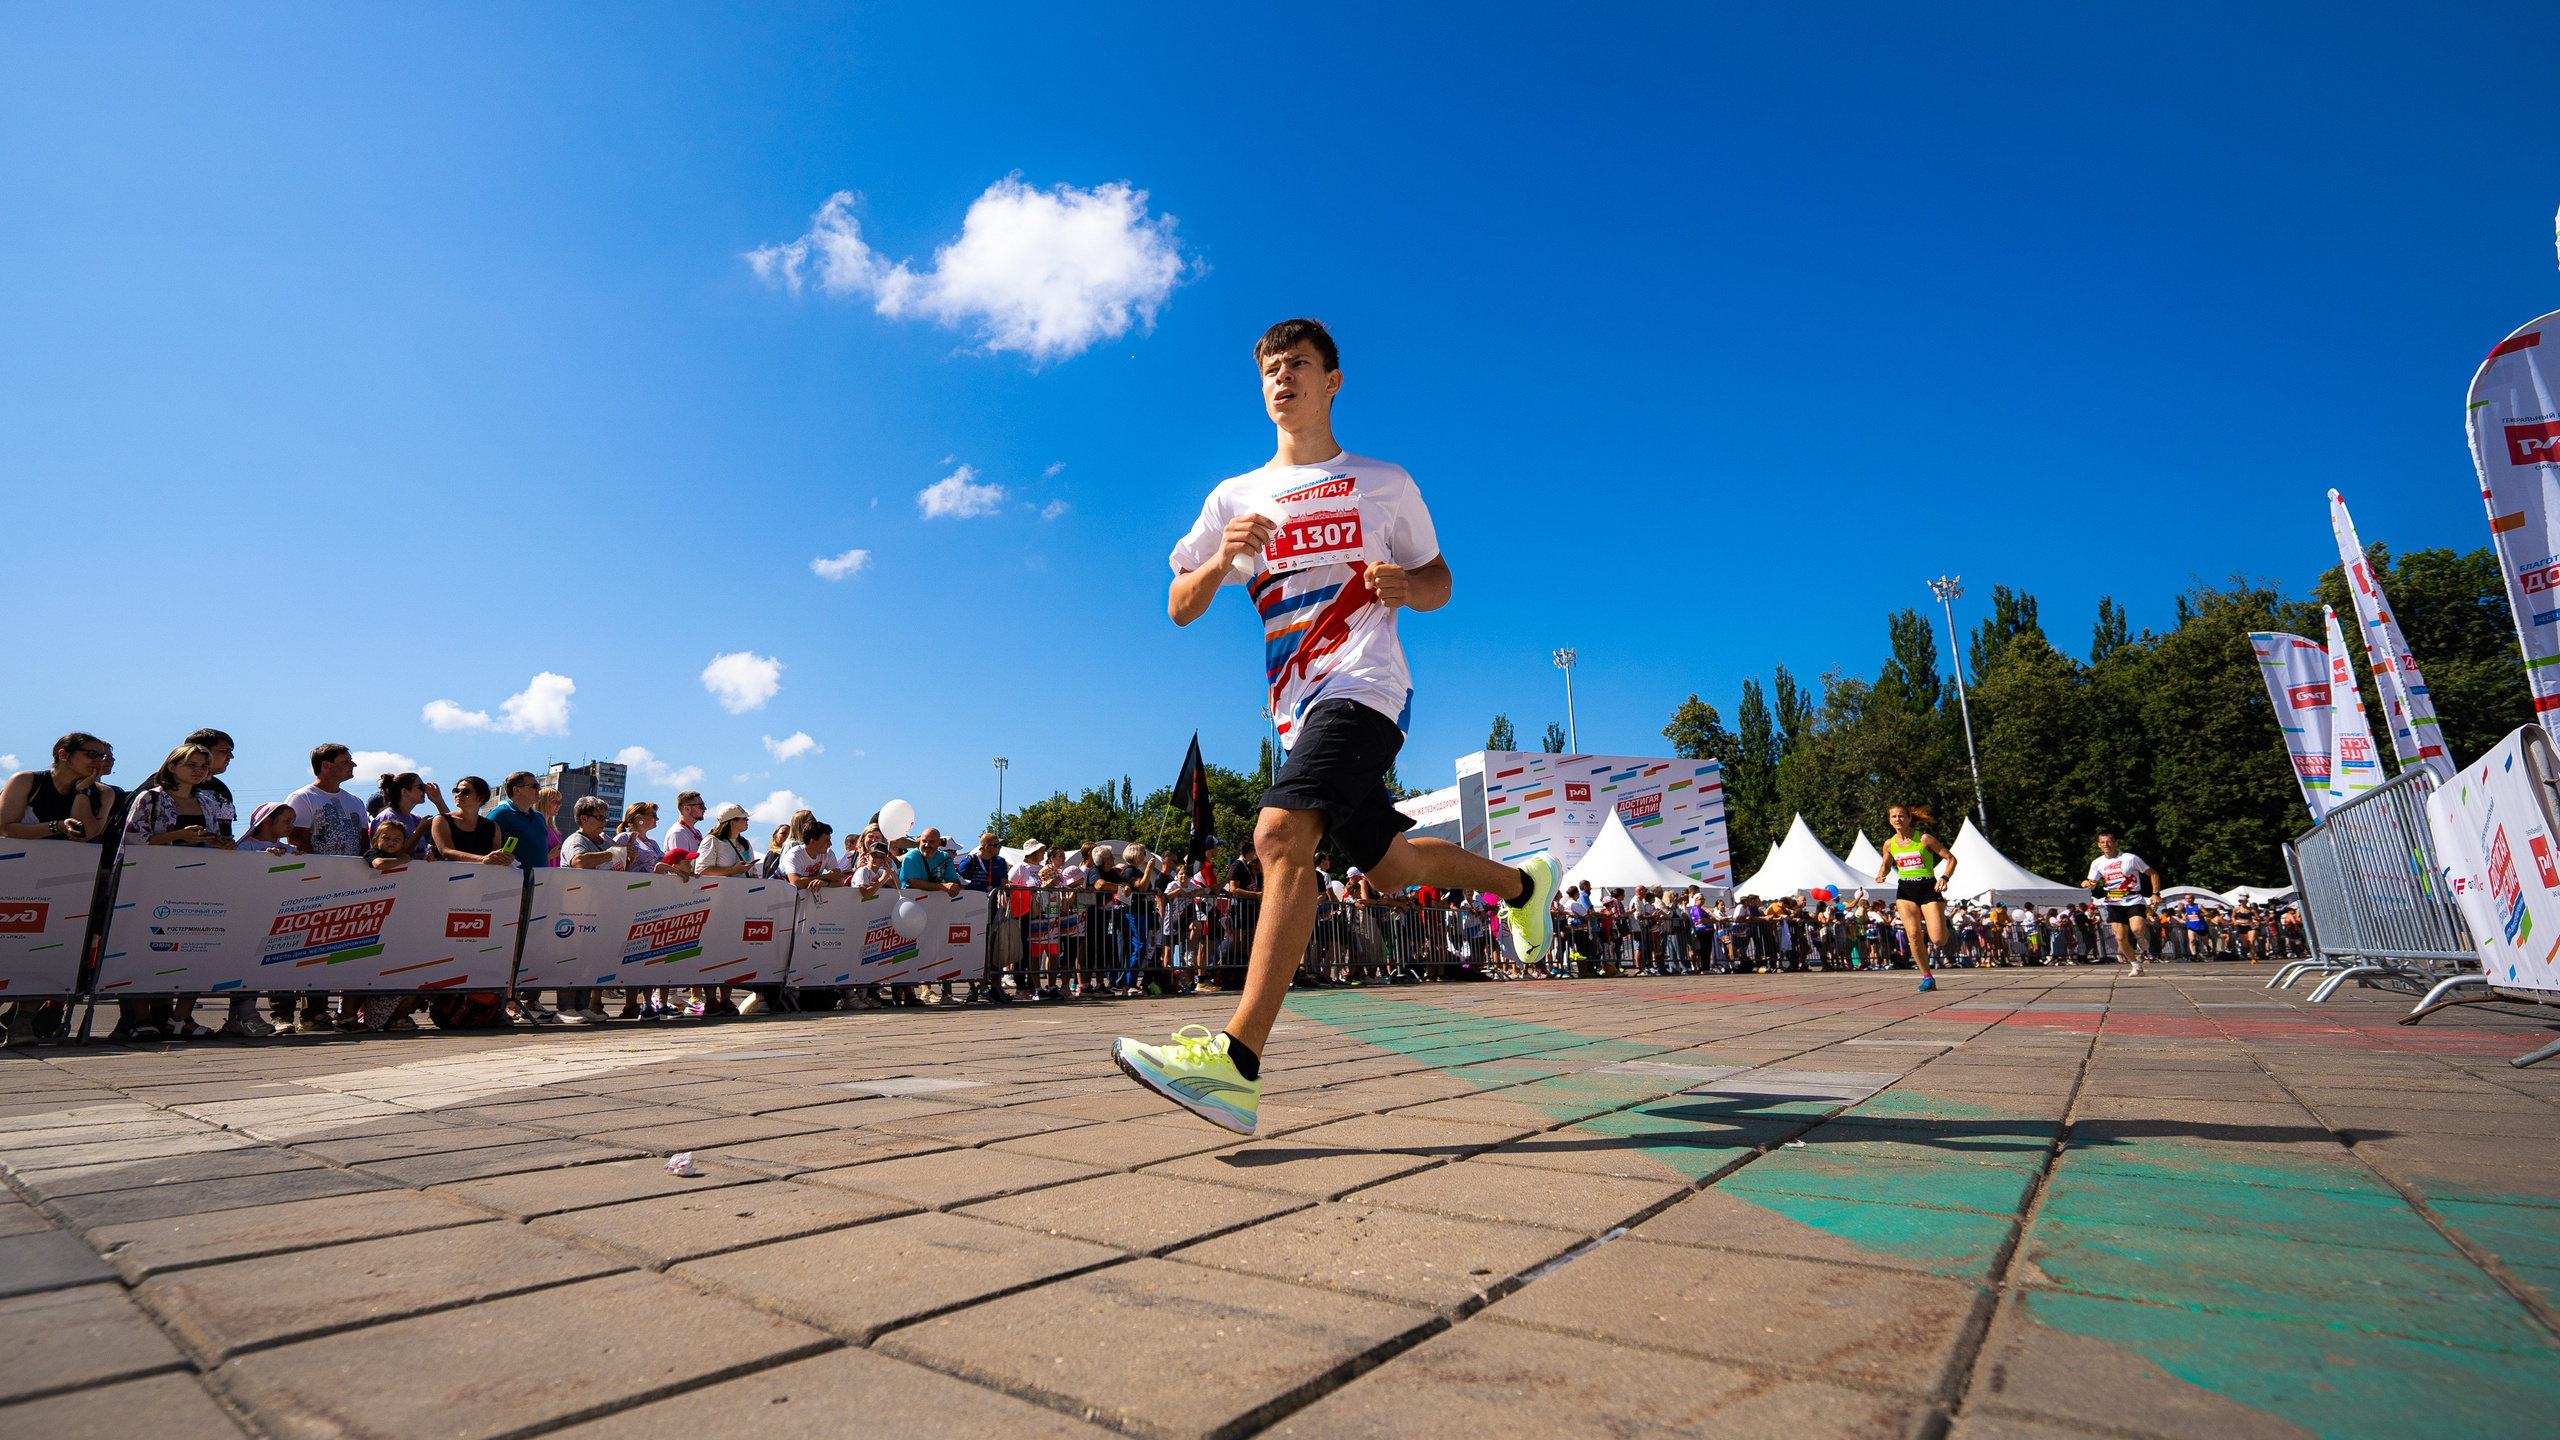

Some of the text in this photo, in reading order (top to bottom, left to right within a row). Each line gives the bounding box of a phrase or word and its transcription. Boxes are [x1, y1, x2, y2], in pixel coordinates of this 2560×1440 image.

[1330, 473, 1347, 481] ЗАБЕГ
[1279, 481, 1348, 504] ОСТИГАЯ
[1291, 521, 1357, 551] 1307
[2520, 554, 2560, 572] БЛАГОТ
[1619, 794, 1659, 812] ДОСТИГАЯ
[1633, 803, 1659, 817] ЦЕЛИ!
[1903, 857, 1922, 866] 1062
[281, 882, 397, 907] СПОРТИВНО-МУЗЫКАЛЬНЫЙ
[278, 902, 324, 915] ПРАЗДНИК
[635, 896, 711, 917] СПОРТИВНО-МУЗЫКАЛЬНЫЙ
[276, 901, 387, 934] ДОСТИГАЯ
[631, 911, 705, 939] ДОСТИГАЯ
[633, 913, 663, 923] ПРАЗДНИК
[284, 932, 302, 941] ВСЕЙ
[310, 916, 380, 943] ЦЕЛИ!
[654, 924, 700, 946] ЦЕЛИ!
[866, 927, 897, 944] ДОСТ
[264, 940, 300, 952] СЕМЬИ
[272, 953, 292, 961] ЧЕСТЬ
[308, 938, 376, 955] ЖЕЛЕЗНОДОРОЖНИКА
[623, 944, 648, 954] СЕМЬИ
